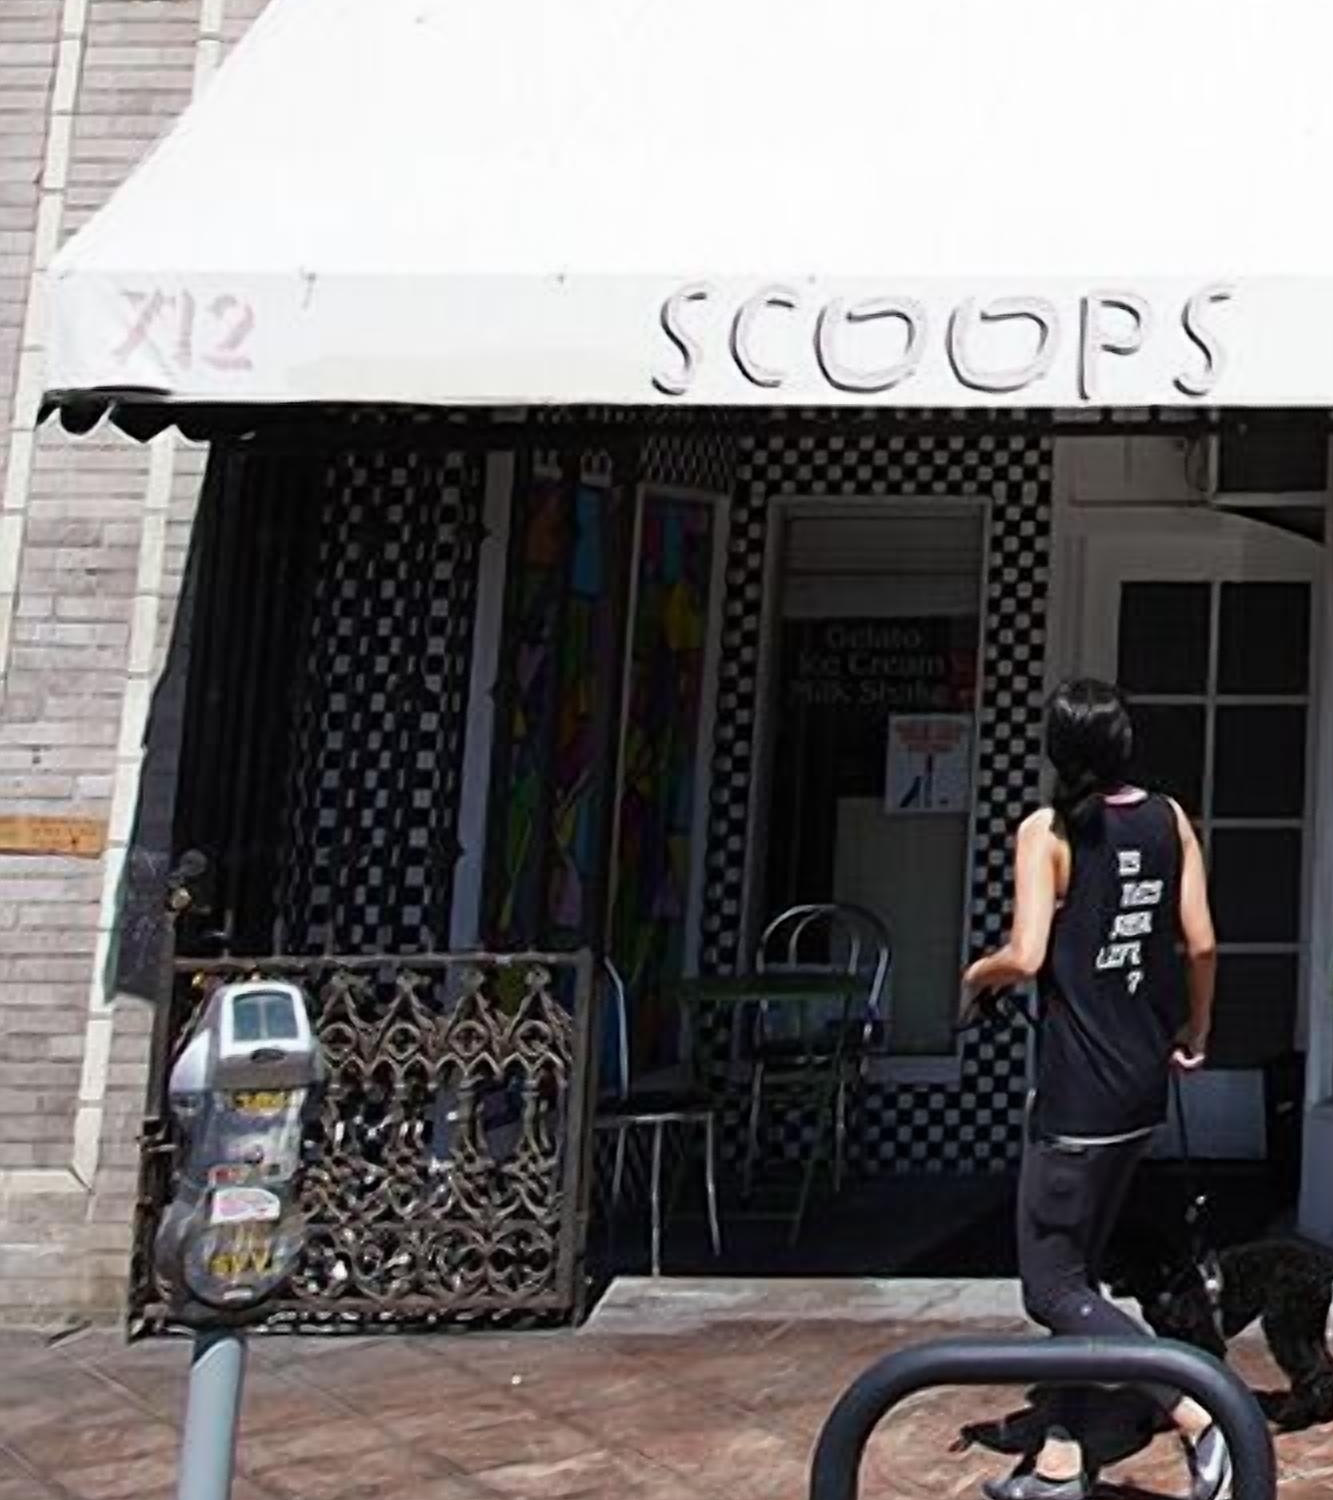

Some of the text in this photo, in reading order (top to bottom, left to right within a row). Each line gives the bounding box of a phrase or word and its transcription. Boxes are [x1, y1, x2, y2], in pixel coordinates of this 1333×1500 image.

[112, 288, 256, 372] 712
[652, 284, 1233, 399] SCOOPS
[827, 621, 921, 650] Gelato
[847, 649, 946, 676] Cream
